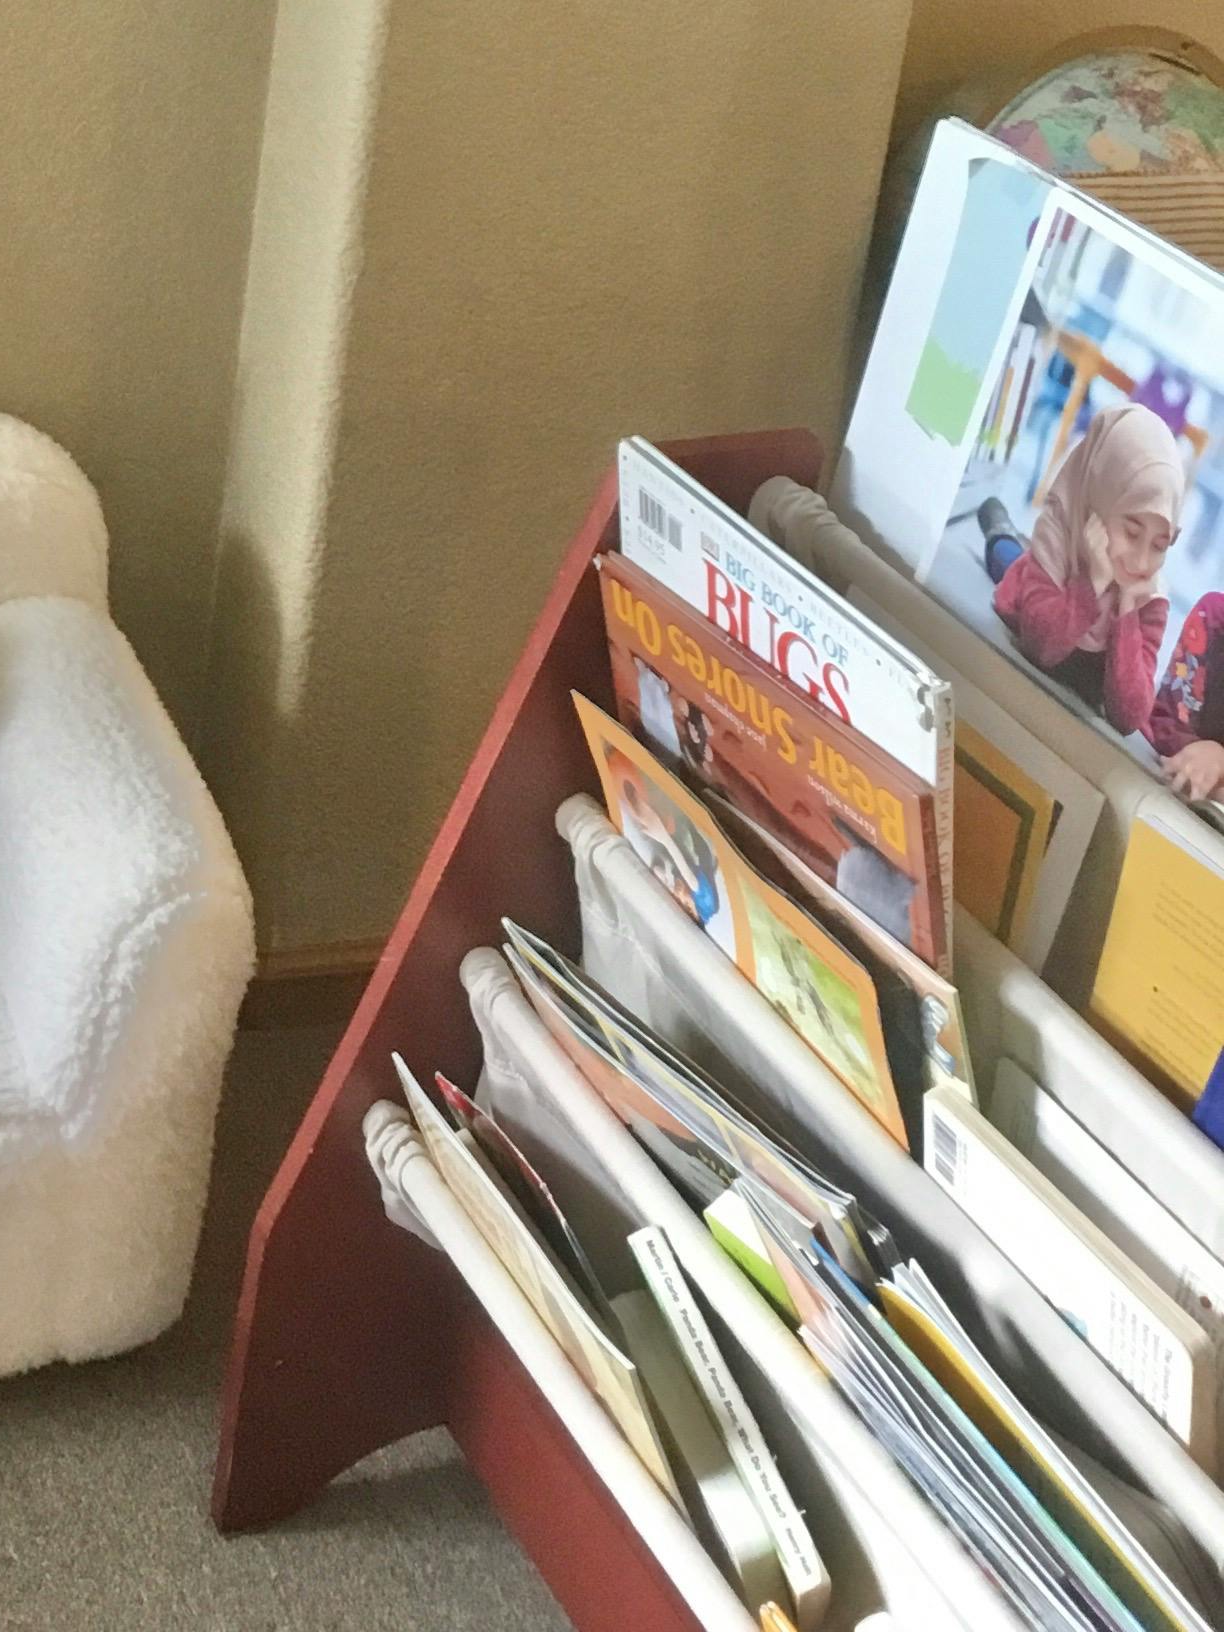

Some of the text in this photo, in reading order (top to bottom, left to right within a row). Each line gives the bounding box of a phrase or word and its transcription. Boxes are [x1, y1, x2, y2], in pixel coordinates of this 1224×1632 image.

[610, 579, 908, 856] Bear Snores On
[703, 557, 854, 727] BUGS
[725, 550, 849, 666] BIG BOOK OF
[646, 1239, 664, 1274] Martin
[680, 1308, 697, 1339] Panda
[695, 1340, 710, 1367] Bear,
[708, 1367, 725, 1399] Panda
[724, 1400, 738, 1427] Bear,
[737, 1427, 755, 1454] What
[751, 1455, 761, 1471] Do
[760, 1473, 771, 1492] You
[769, 1493, 786, 1519] See?
